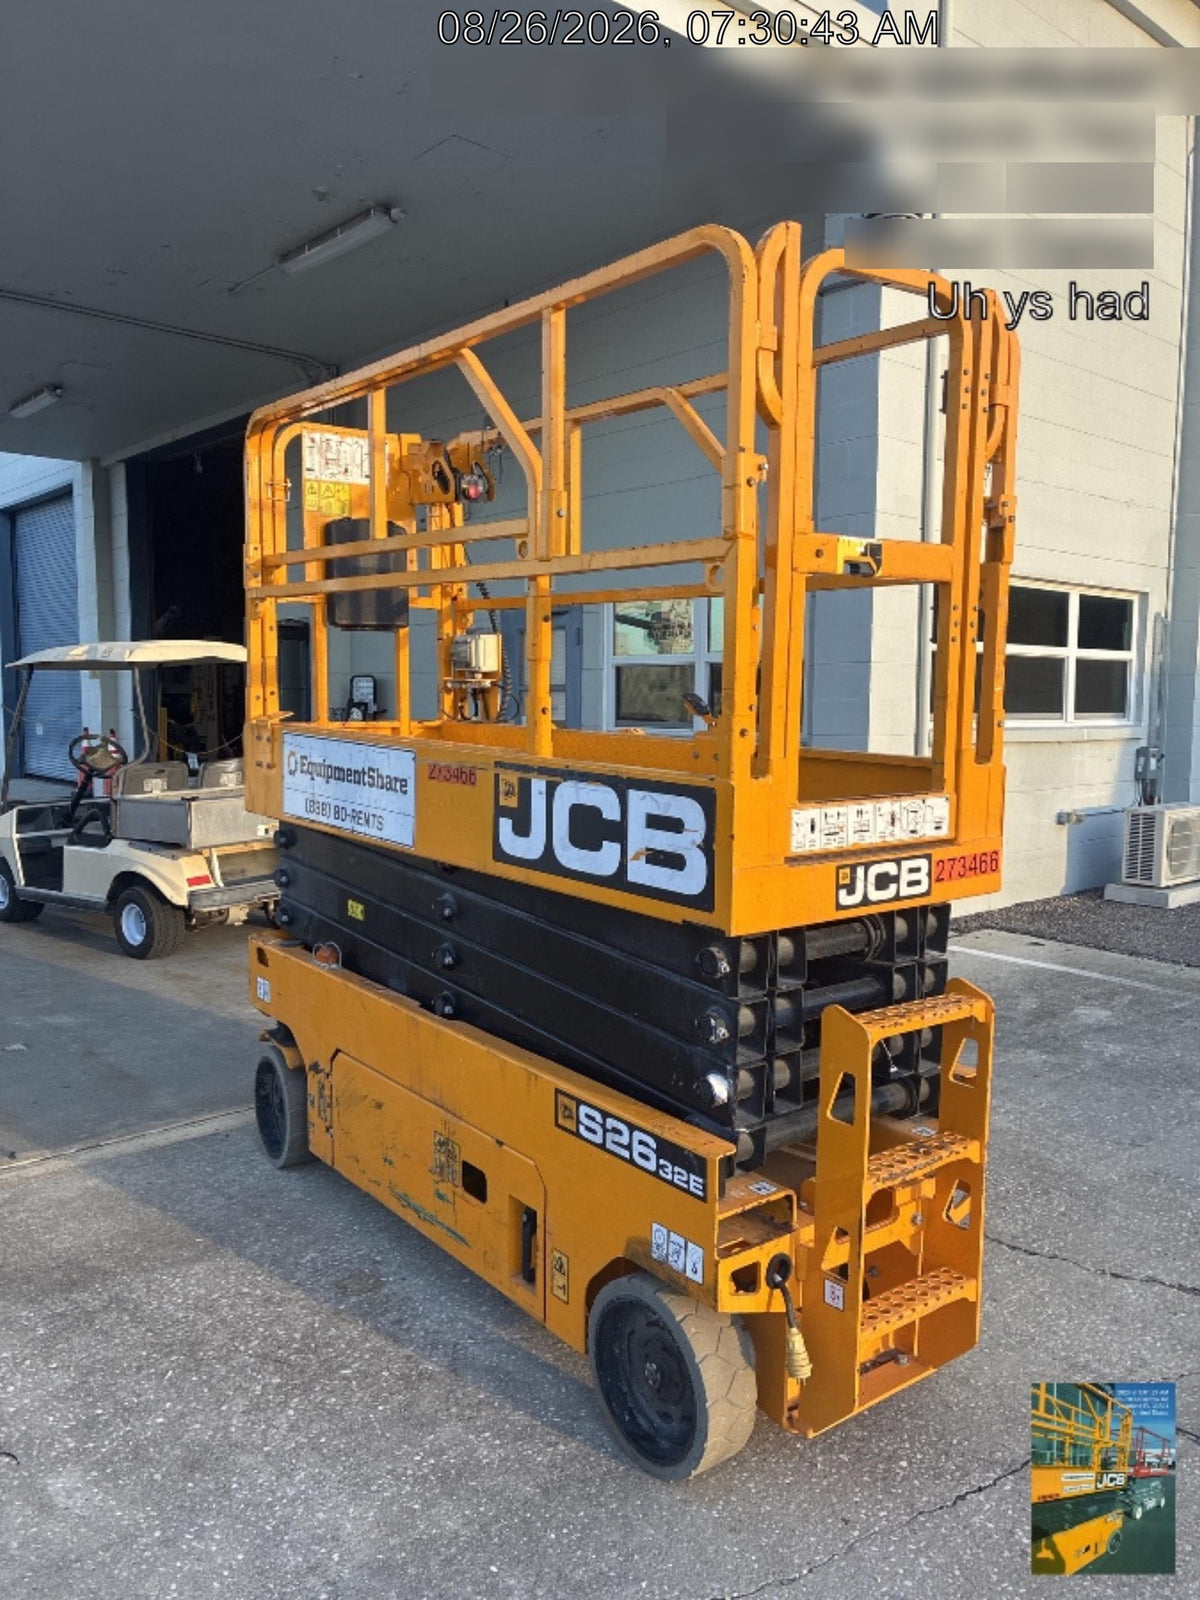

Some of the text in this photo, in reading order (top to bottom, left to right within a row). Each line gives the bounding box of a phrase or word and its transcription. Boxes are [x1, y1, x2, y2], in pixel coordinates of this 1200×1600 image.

[299, 754, 409, 796] EquipmentShare
[498, 777, 709, 896] JCB
[837, 857, 929, 906] JCB
[935, 850, 999, 883] 273466
[578, 1103, 704, 1198] S26 32E
